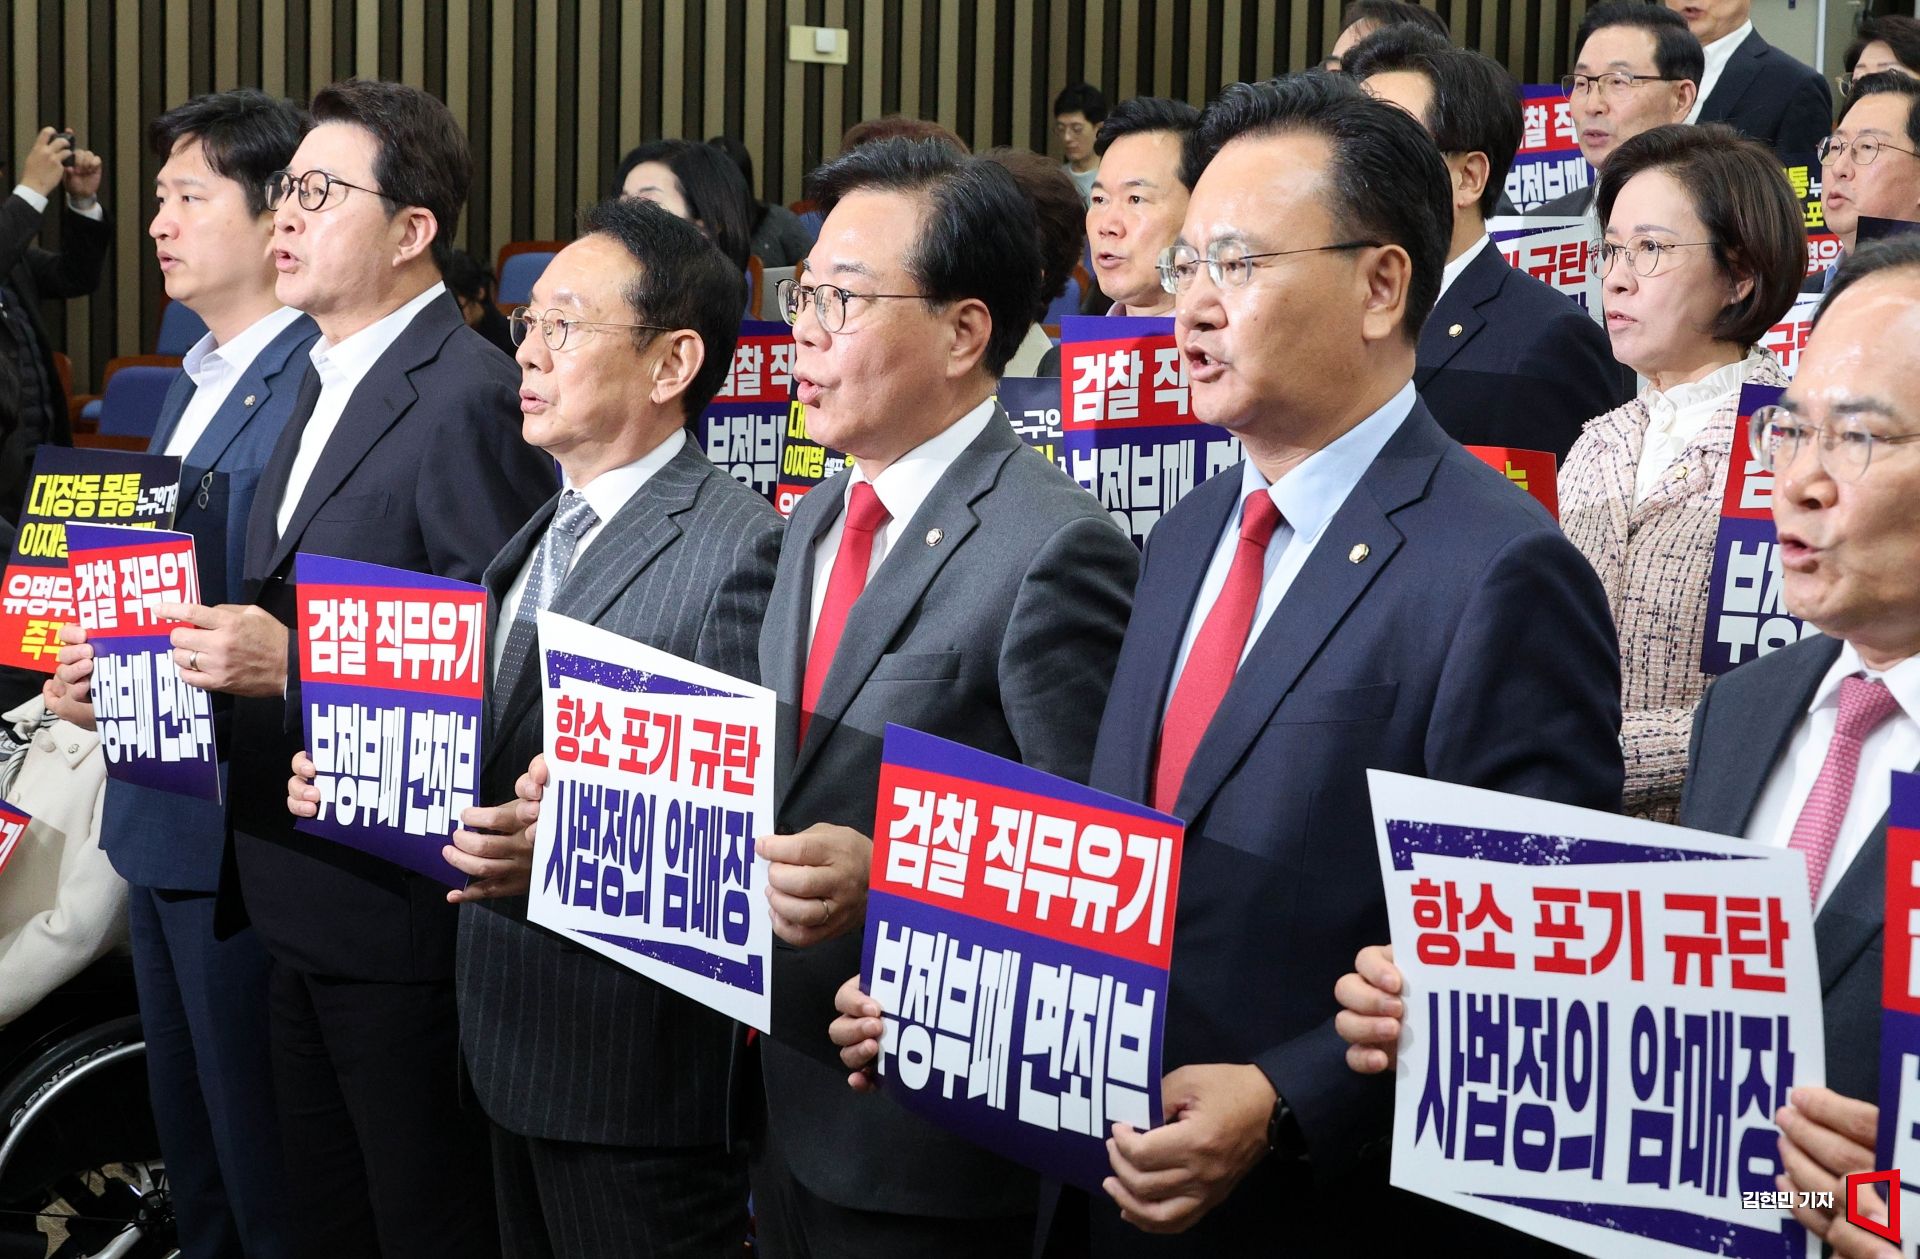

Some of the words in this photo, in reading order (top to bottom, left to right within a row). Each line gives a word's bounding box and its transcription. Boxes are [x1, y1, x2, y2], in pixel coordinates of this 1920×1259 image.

[1519, 105, 1548, 149] 찰
[1784, 166, 1809, 198] 통
[1528, 240, 1588, 286] 규탄
[1073, 350, 1144, 423] 검찰
[27, 473, 101, 517] 대장동
[97, 473, 141, 517] 몸통
[784, 444, 826, 478] 이재명
[2, 574, 76, 618] 유명무
[75, 560, 118, 630] 검찰
[119, 549, 199, 626] 직무유기
[308, 597, 369, 675] 검찰
[376, 600, 482, 683] 직무유기
[311, 703, 405, 828] 부정부패
[404, 709, 477, 836] 면죄부
[555, 694, 611, 768] 항소
[618, 706, 682, 782] 포기
[690, 718, 761, 796] 규탄
[543, 780, 656, 924] 사법정의
[662, 798, 755, 946] 암매장
[885, 786, 979, 899] 검찰
[983, 805, 1173, 946] 직무유기
[1410, 878, 1515, 969] 항소
[1532, 887, 1644, 981] 포기
[1664, 893, 1789, 993] 규탄
[869, 920, 1022, 1110] 부정부패
[1018, 962, 1156, 1139] 면죄부
[1414, 990, 1609, 1180] 사법정의
[1627, 1004, 1795, 1206] 암매장
